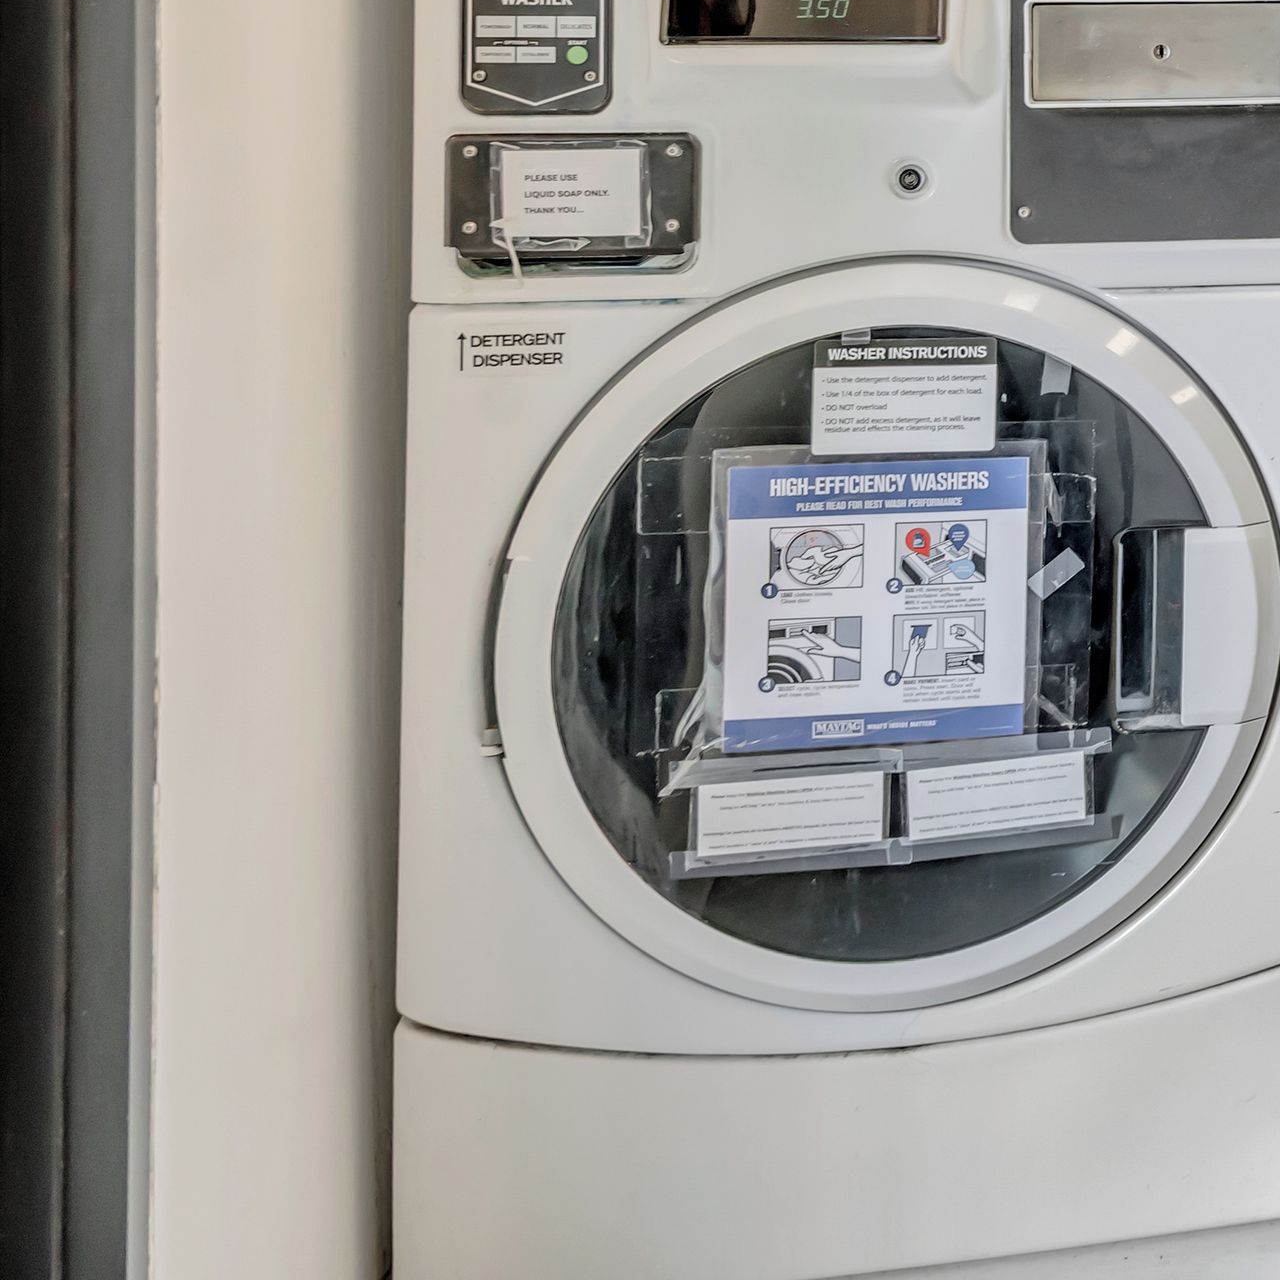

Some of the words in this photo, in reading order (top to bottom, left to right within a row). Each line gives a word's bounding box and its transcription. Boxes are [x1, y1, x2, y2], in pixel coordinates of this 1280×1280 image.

[470, 332, 566, 348] DETERGENT
[473, 352, 563, 368] DISPENSER
[828, 347, 885, 361] WASHER
[889, 345, 987, 359] INSTRUCTIONS
[770, 474, 907, 497] HIGH-EFFICIENCY
[911, 471, 989, 492] WASHERS
